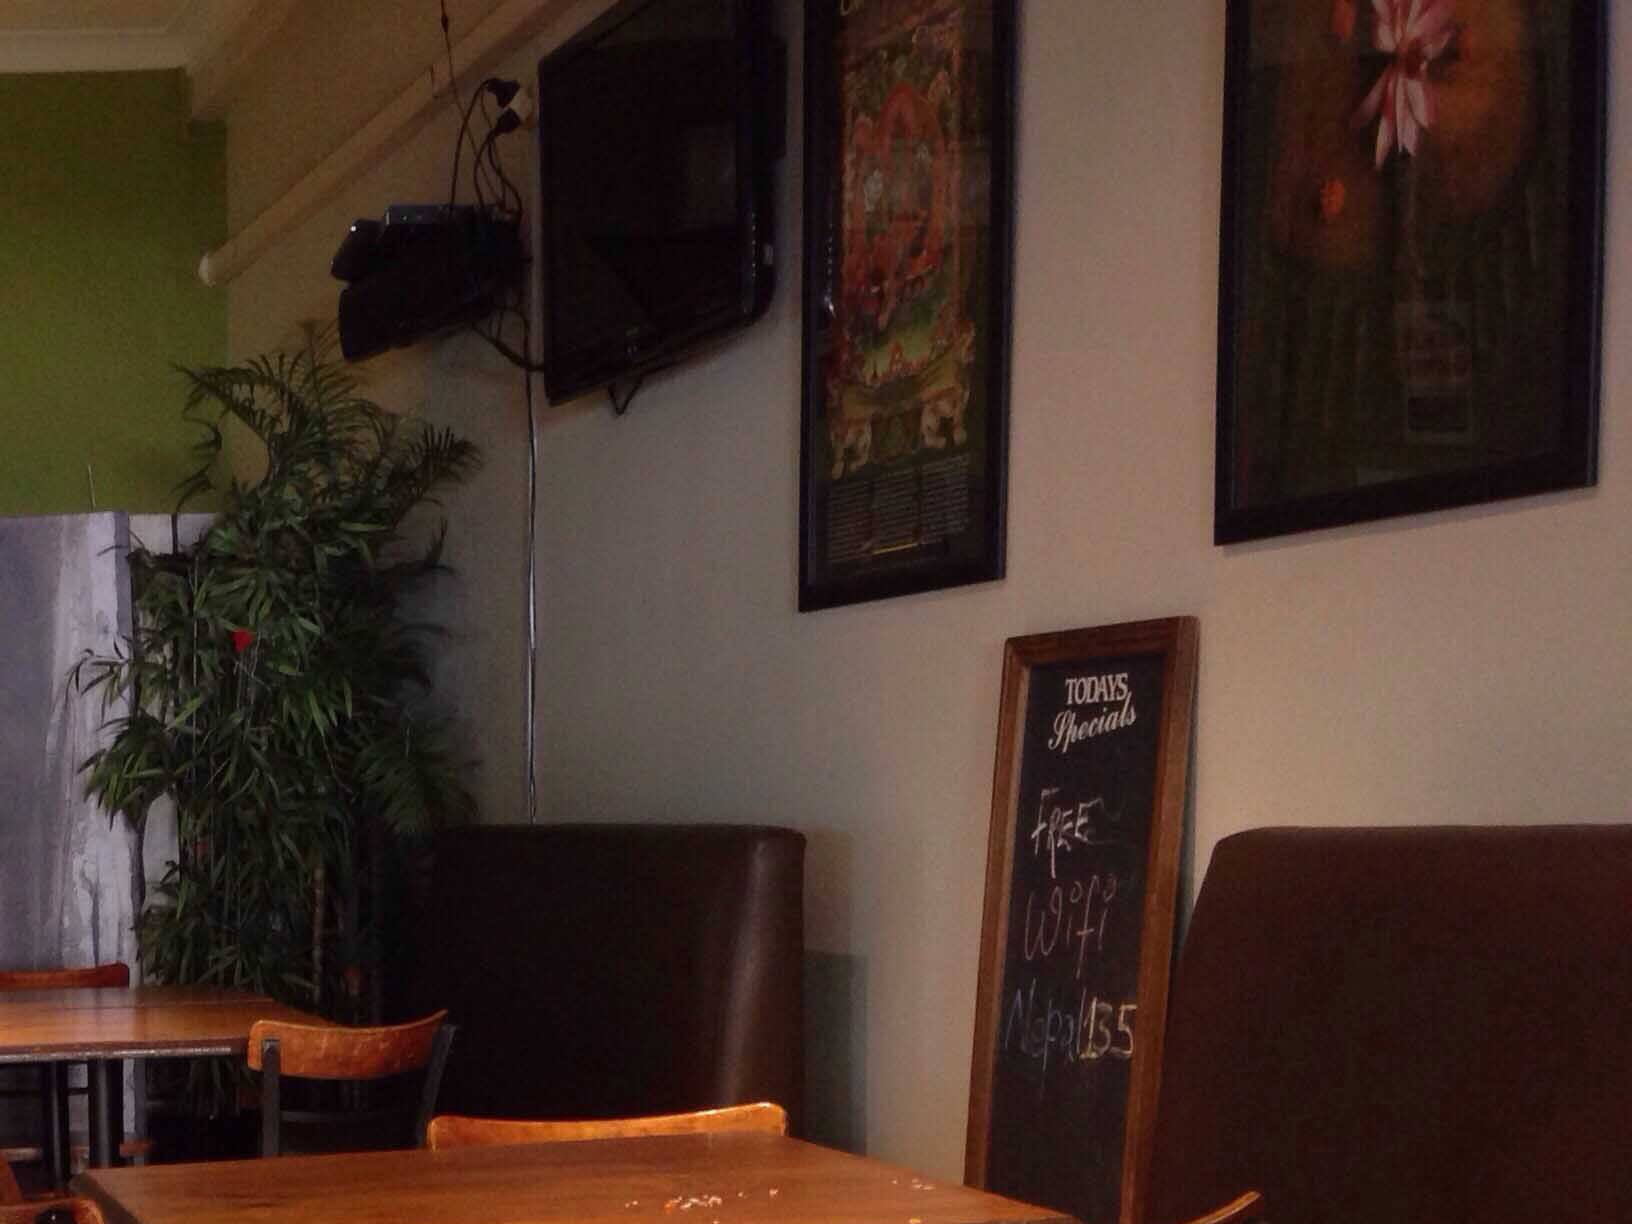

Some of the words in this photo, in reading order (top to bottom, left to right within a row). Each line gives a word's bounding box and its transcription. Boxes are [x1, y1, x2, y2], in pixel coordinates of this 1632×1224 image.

[1065, 672, 1130, 705] TODAYS
[1048, 691, 1137, 753] Specials
[1031, 787, 1106, 879] FREE
